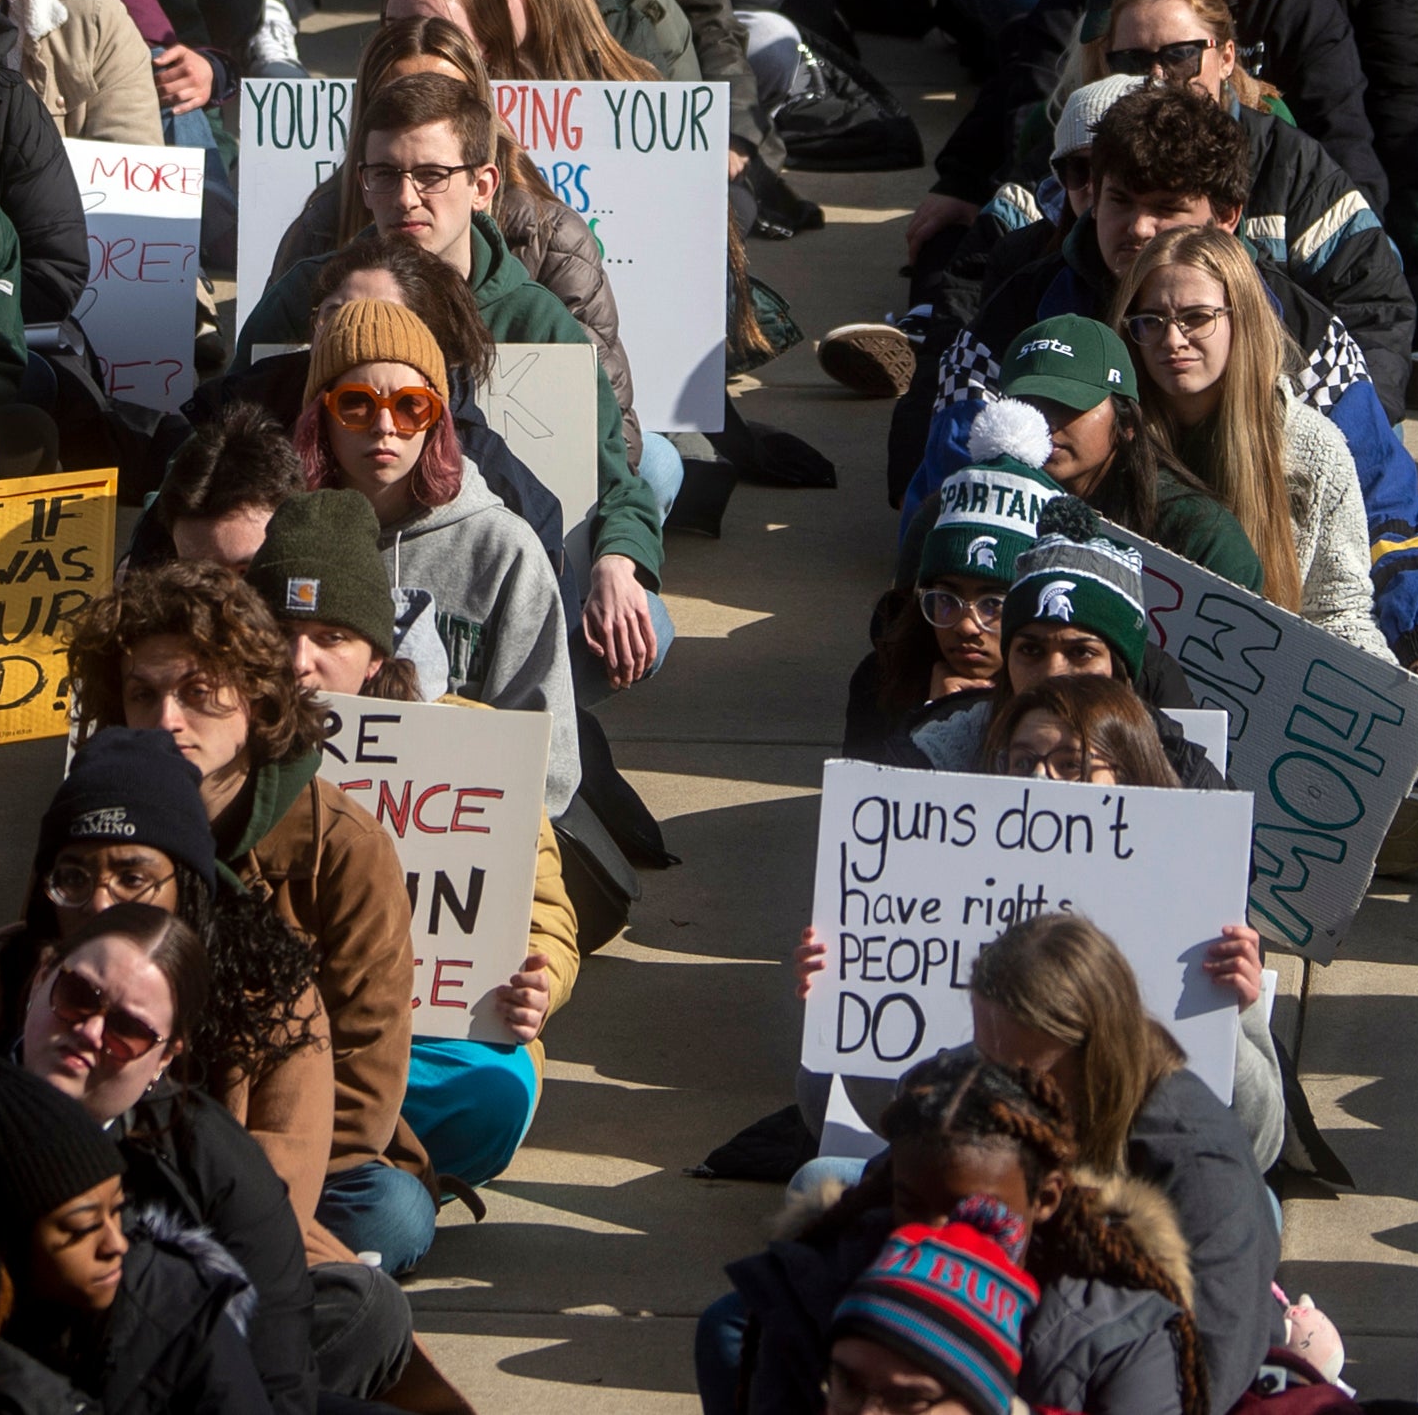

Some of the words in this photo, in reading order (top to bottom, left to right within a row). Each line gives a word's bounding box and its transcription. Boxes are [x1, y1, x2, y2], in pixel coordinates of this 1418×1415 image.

[245, 79, 355, 152] YOU'R
[492, 84, 583, 153] RING
[603, 86, 714, 154] YOUR
[87, 235, 197, 284] ORE?
[1107, 367, 1123, 384] R
[20, 494, 84, 545] IF
[319, 711, 402, 764] RE
[340, 779, 505, 838] NCE
[851, 794, 978, 883] guns
[995, 788, 1134, 860] don't
[840, 841, 942, 926] have
[839, 931, 993, 989] PEOPL
[928, 1254, 1027, 1337] BUR
